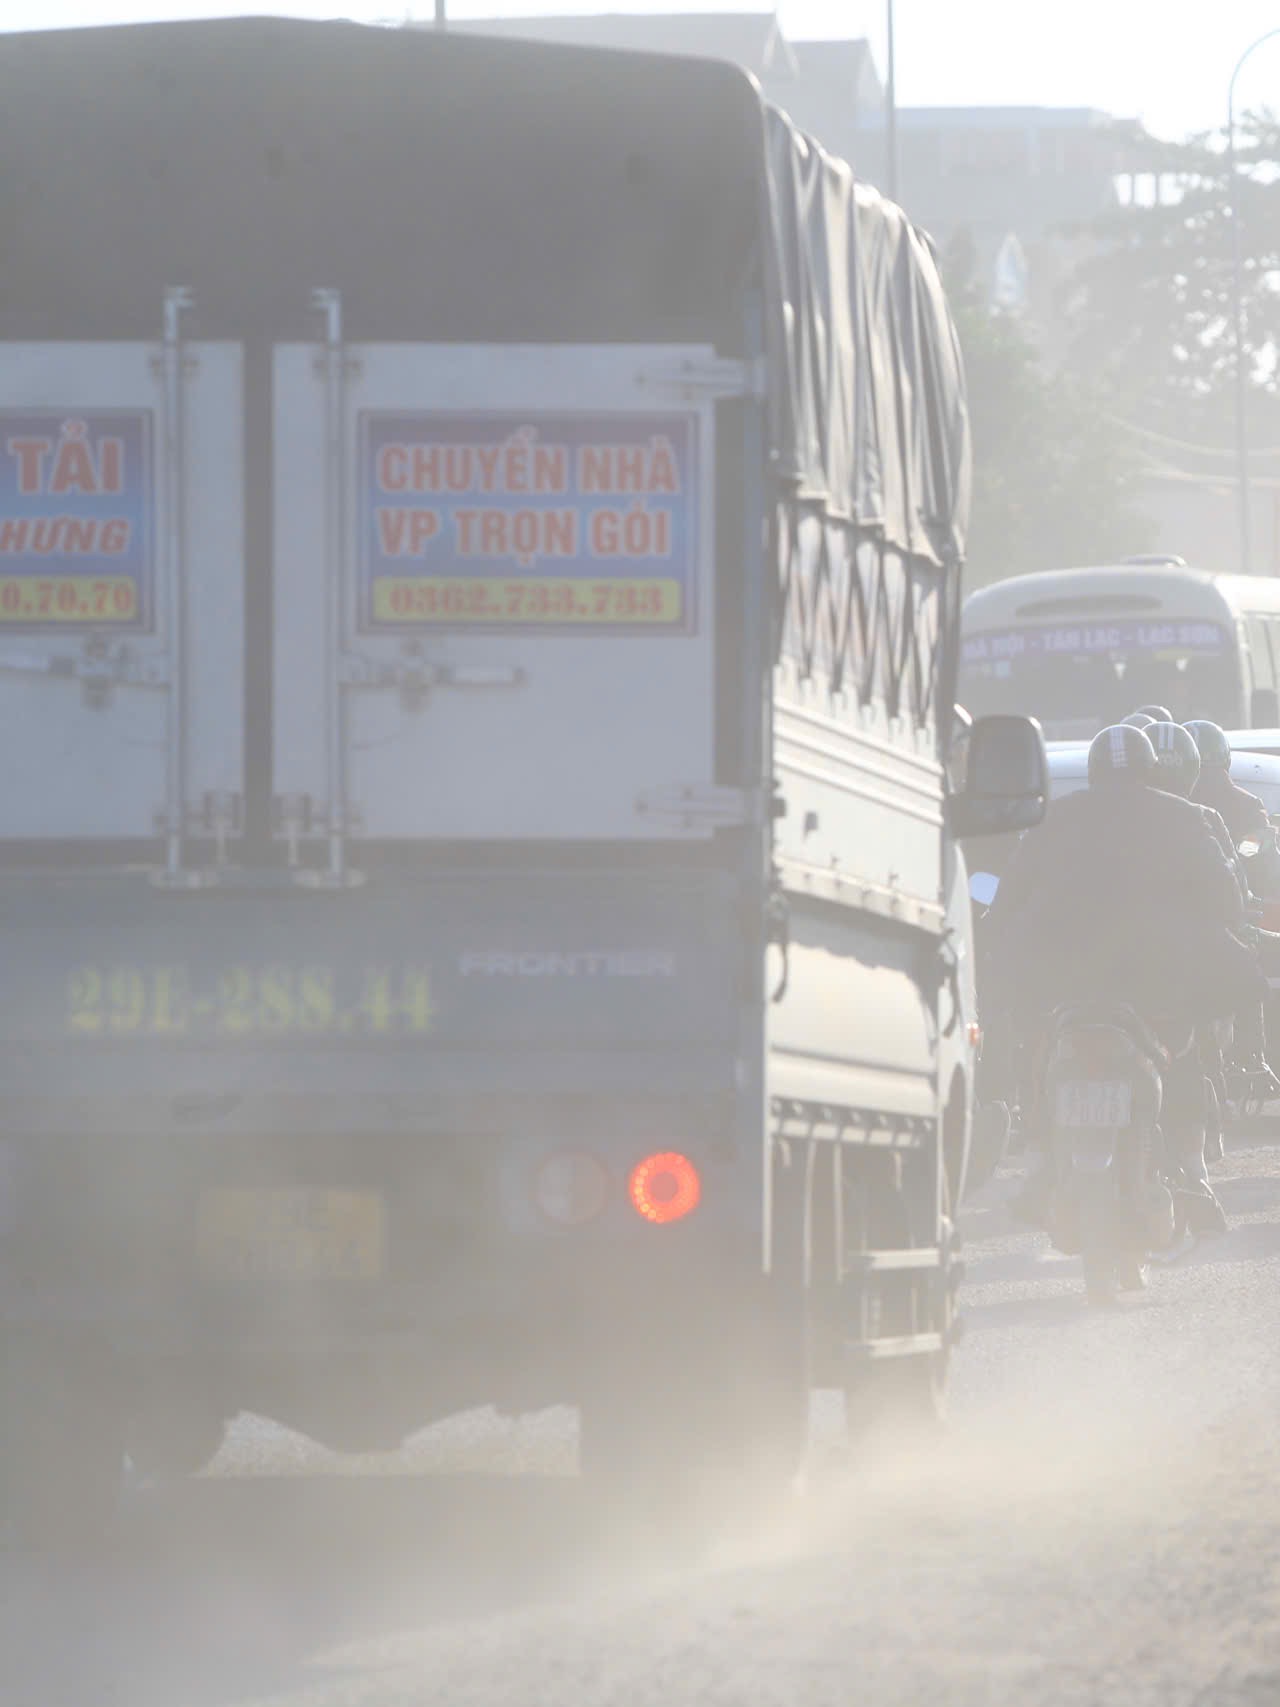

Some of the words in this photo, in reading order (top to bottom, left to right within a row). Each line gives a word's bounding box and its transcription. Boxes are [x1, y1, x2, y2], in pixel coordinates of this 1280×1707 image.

[377, 424, 567, 492] CHUYỂN
[577, 435, 680, 493] NHÀ
[376, 507, 441, 556] VP
[453, 508, 577, 568] TRỌN
[590, 497, 671, 556] GÓI
